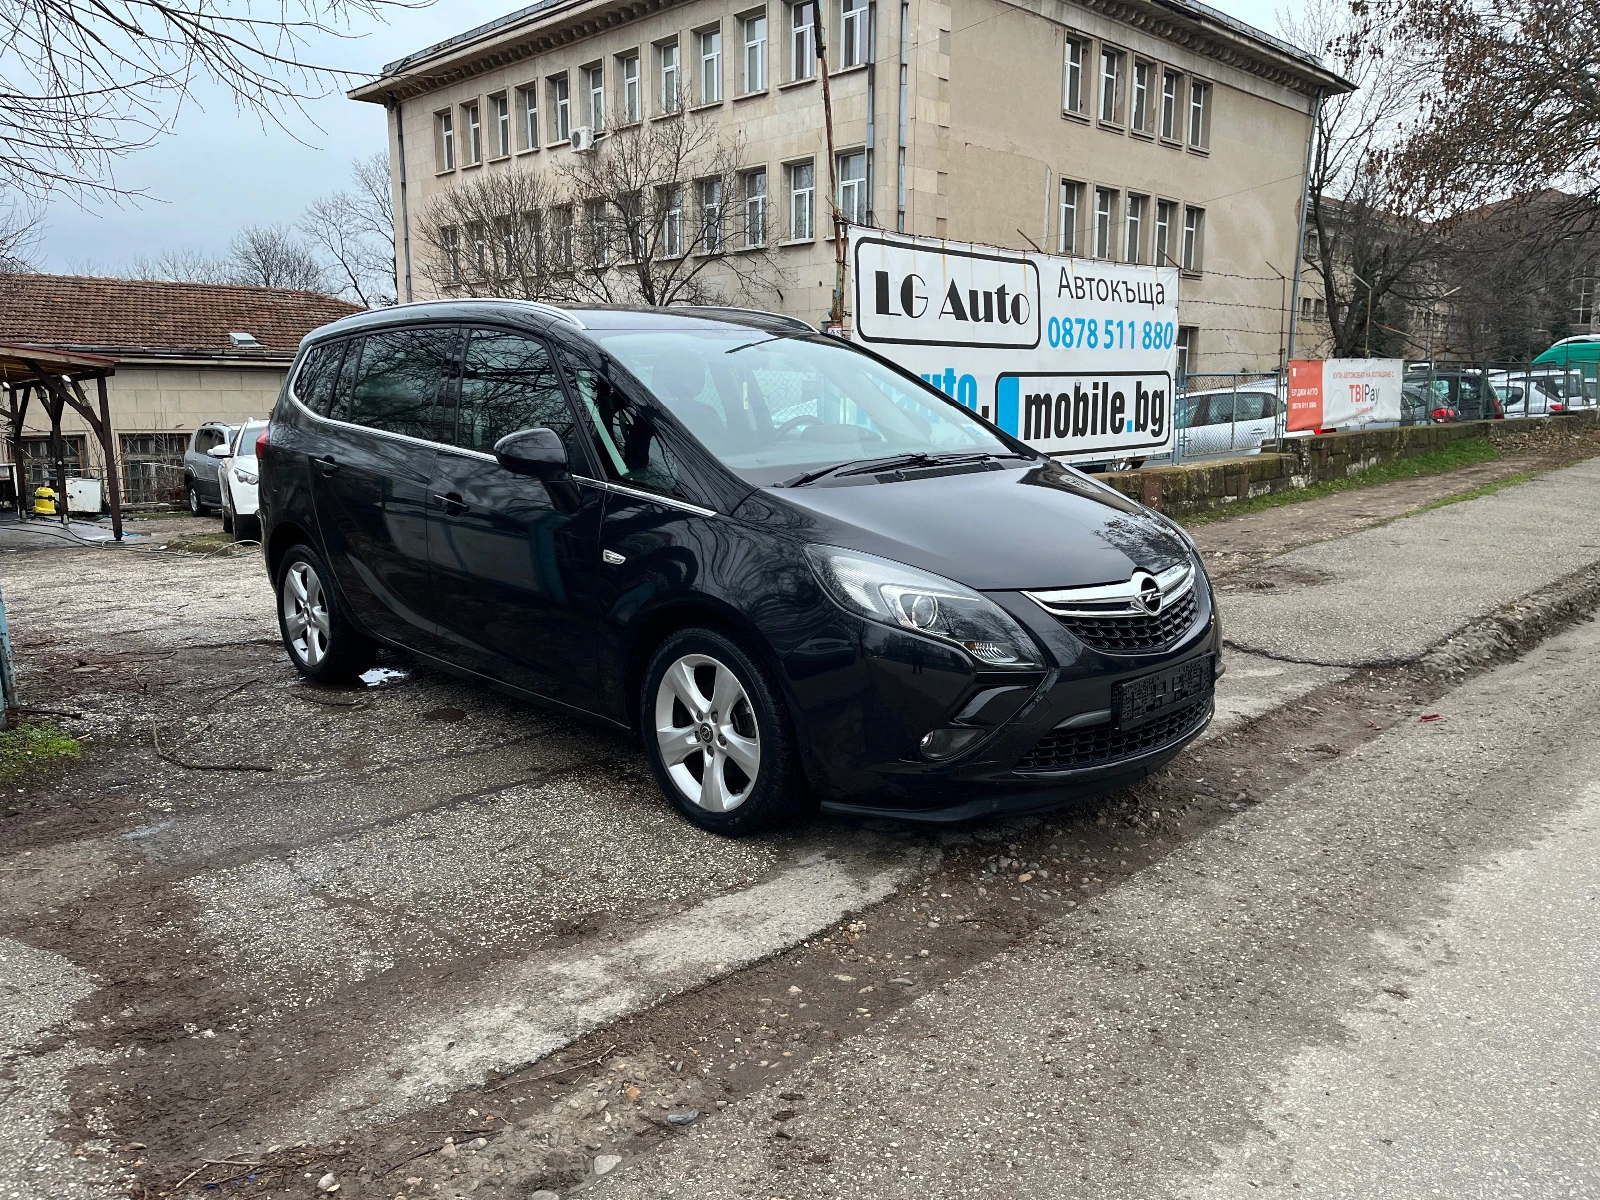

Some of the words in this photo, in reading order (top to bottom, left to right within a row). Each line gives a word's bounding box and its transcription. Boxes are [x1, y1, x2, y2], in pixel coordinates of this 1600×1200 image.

[875, 270, 929, 319] LG
[939, 278, 1031, 326] Auto
[1058, 266, 1165, 310] Автокъща
[1048, 316, 1098, 349] 0878
[1103, 319, 1136, 350] 511
[1142, 321, 1174, 350] 880
[1023, 381, 1165, 440] mobile.bg
[1349, 384, 1380, 406] TBIPay
